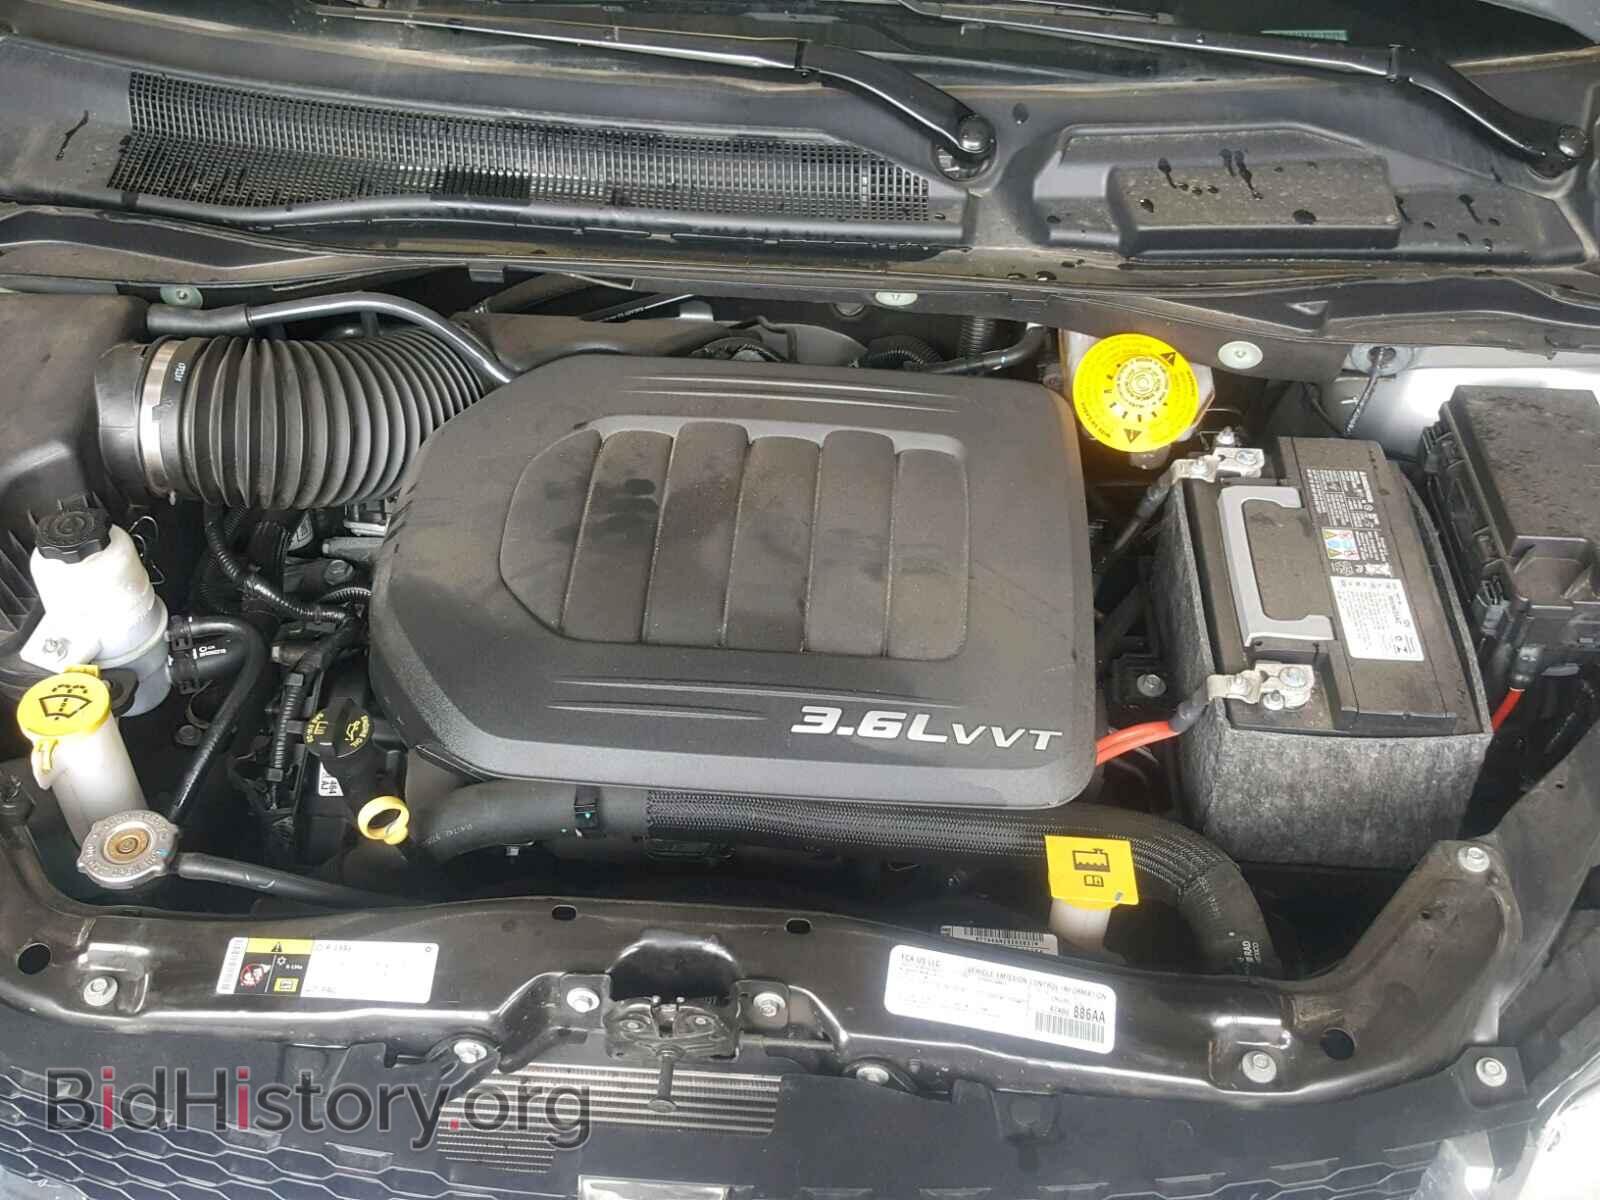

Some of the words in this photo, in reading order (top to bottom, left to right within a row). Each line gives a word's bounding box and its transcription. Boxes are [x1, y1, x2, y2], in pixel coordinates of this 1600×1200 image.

[791, 705, 948, 743] 3.6L
[951, 722, 1064, 751] VVT
[1073, 1006, 1106, 1025] 886AA
